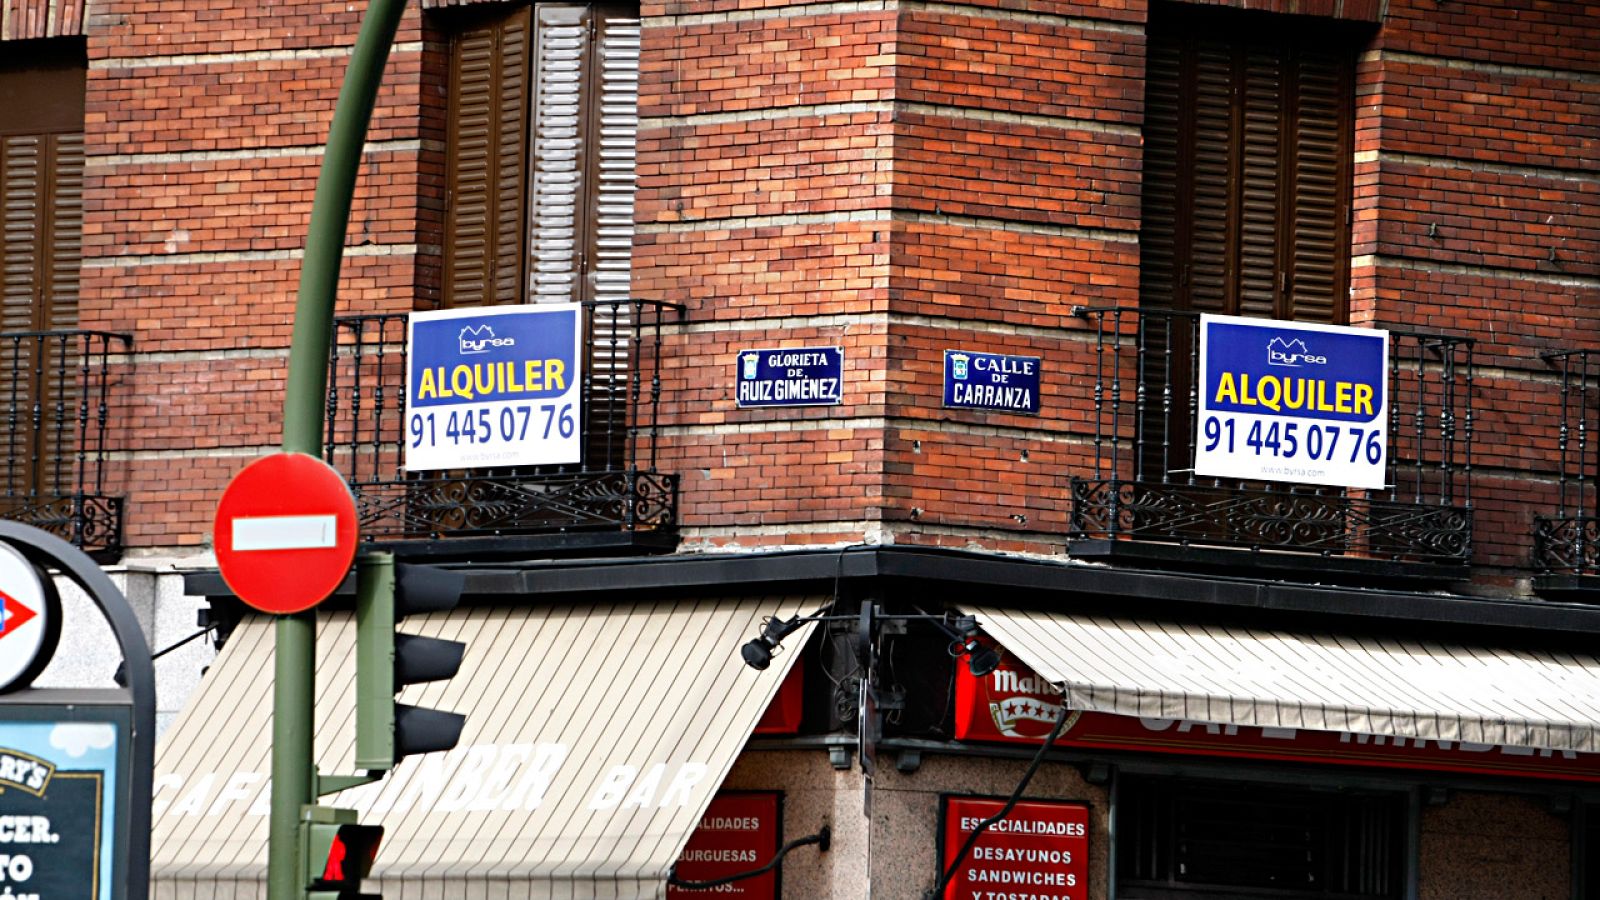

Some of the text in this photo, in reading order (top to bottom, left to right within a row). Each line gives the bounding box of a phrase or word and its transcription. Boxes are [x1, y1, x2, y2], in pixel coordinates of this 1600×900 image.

[461, 336, 515, 351] byrsa
[768, 351, 828, 367] GLORIETA
[974, 356, 1034, 376] CALLE
[1271, 350, 1327, 365] byrsa
[418, 359, 566, 400] ALQUILER
[787, 368, 804, 378] DE
[991, 373, 1008, 384] DE
[740, 376, 838, 401] RUIZ GIMÉNEZ
[953, 382, 1031, 409] CARRANZA
[1215, 372, 1374, 415] ALQUILER
[410, 403, 575, 449] 91 445 07 76
[1204, 416, 1382, 466] 91 445 07 76
[993, 669, 1060, 695] Mah
[588, 762, 708, 811] BAR
[973, 847, 1072, 864] DESAYUNOS
[968, 869, 1076, 887] SANDWICHES
[972, 891, 982, 900] Y
